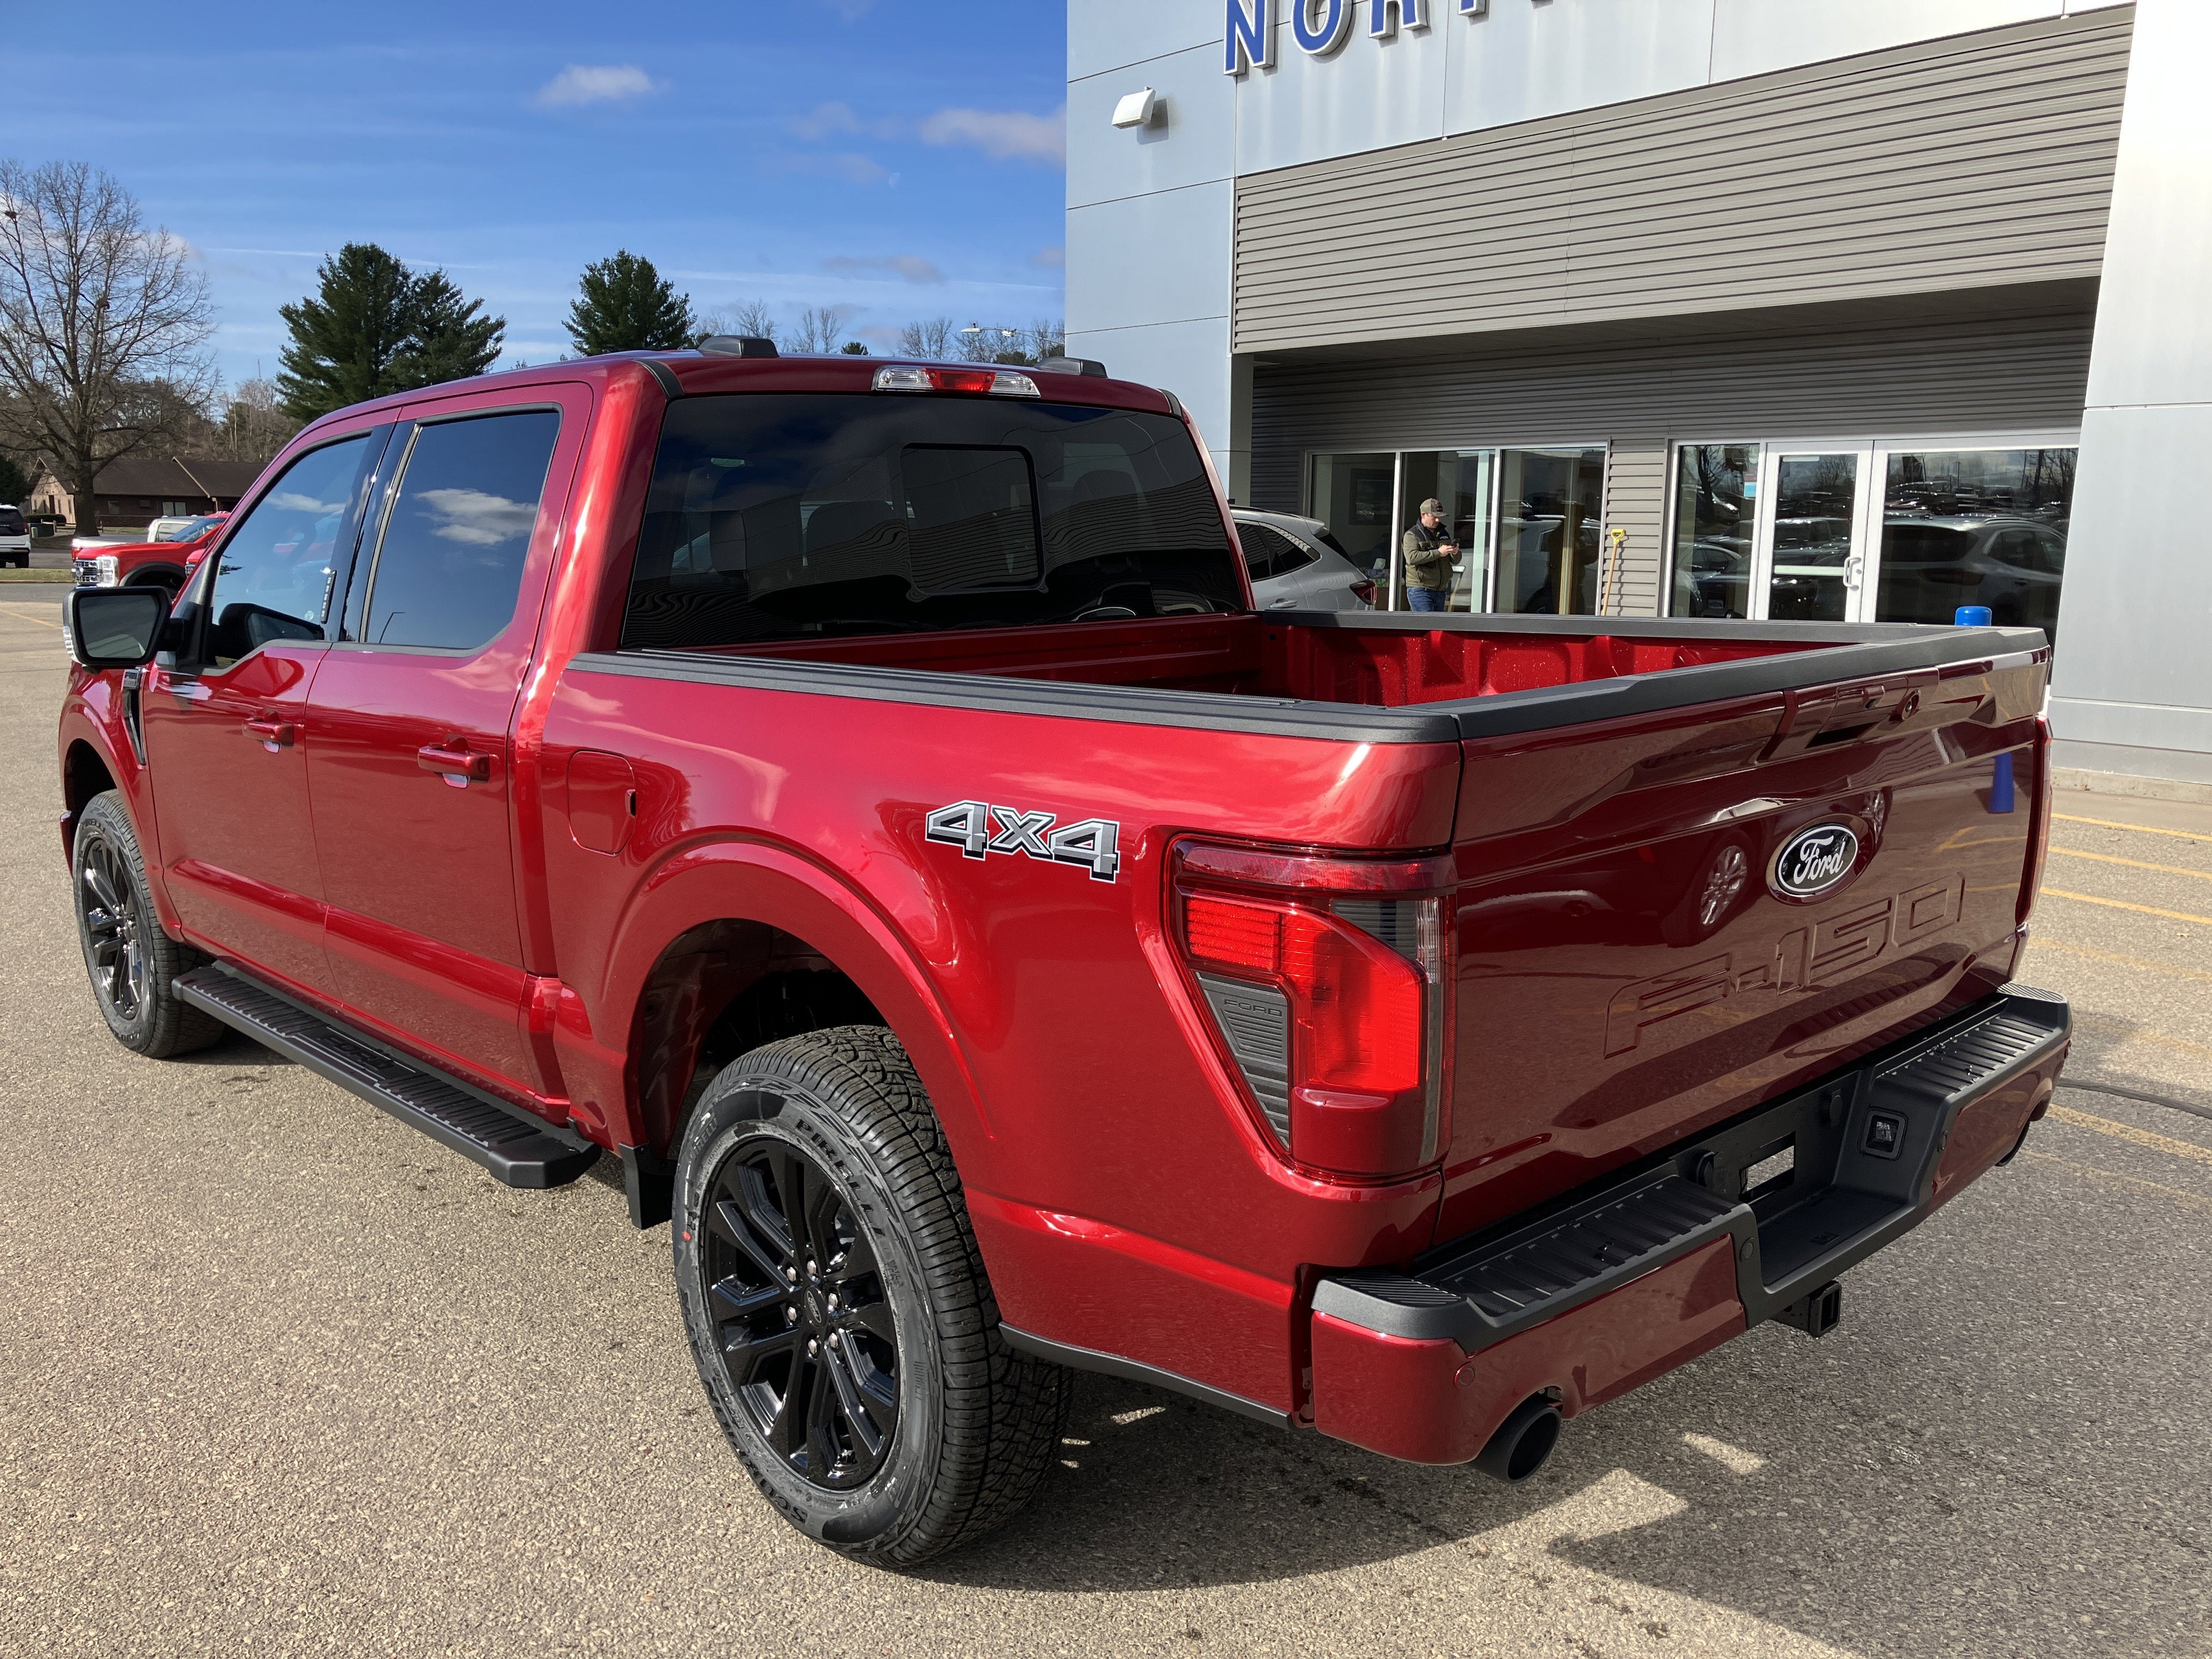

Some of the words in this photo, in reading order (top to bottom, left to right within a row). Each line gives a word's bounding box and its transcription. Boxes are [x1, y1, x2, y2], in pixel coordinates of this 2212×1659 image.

[1793, 836, 1845, 884] Ford
[1604, 872, 1965, 1059] F-150
[1224, 999, 1283, 1018] FORD
[796, 1119, 885, 1236] PIRELLI
